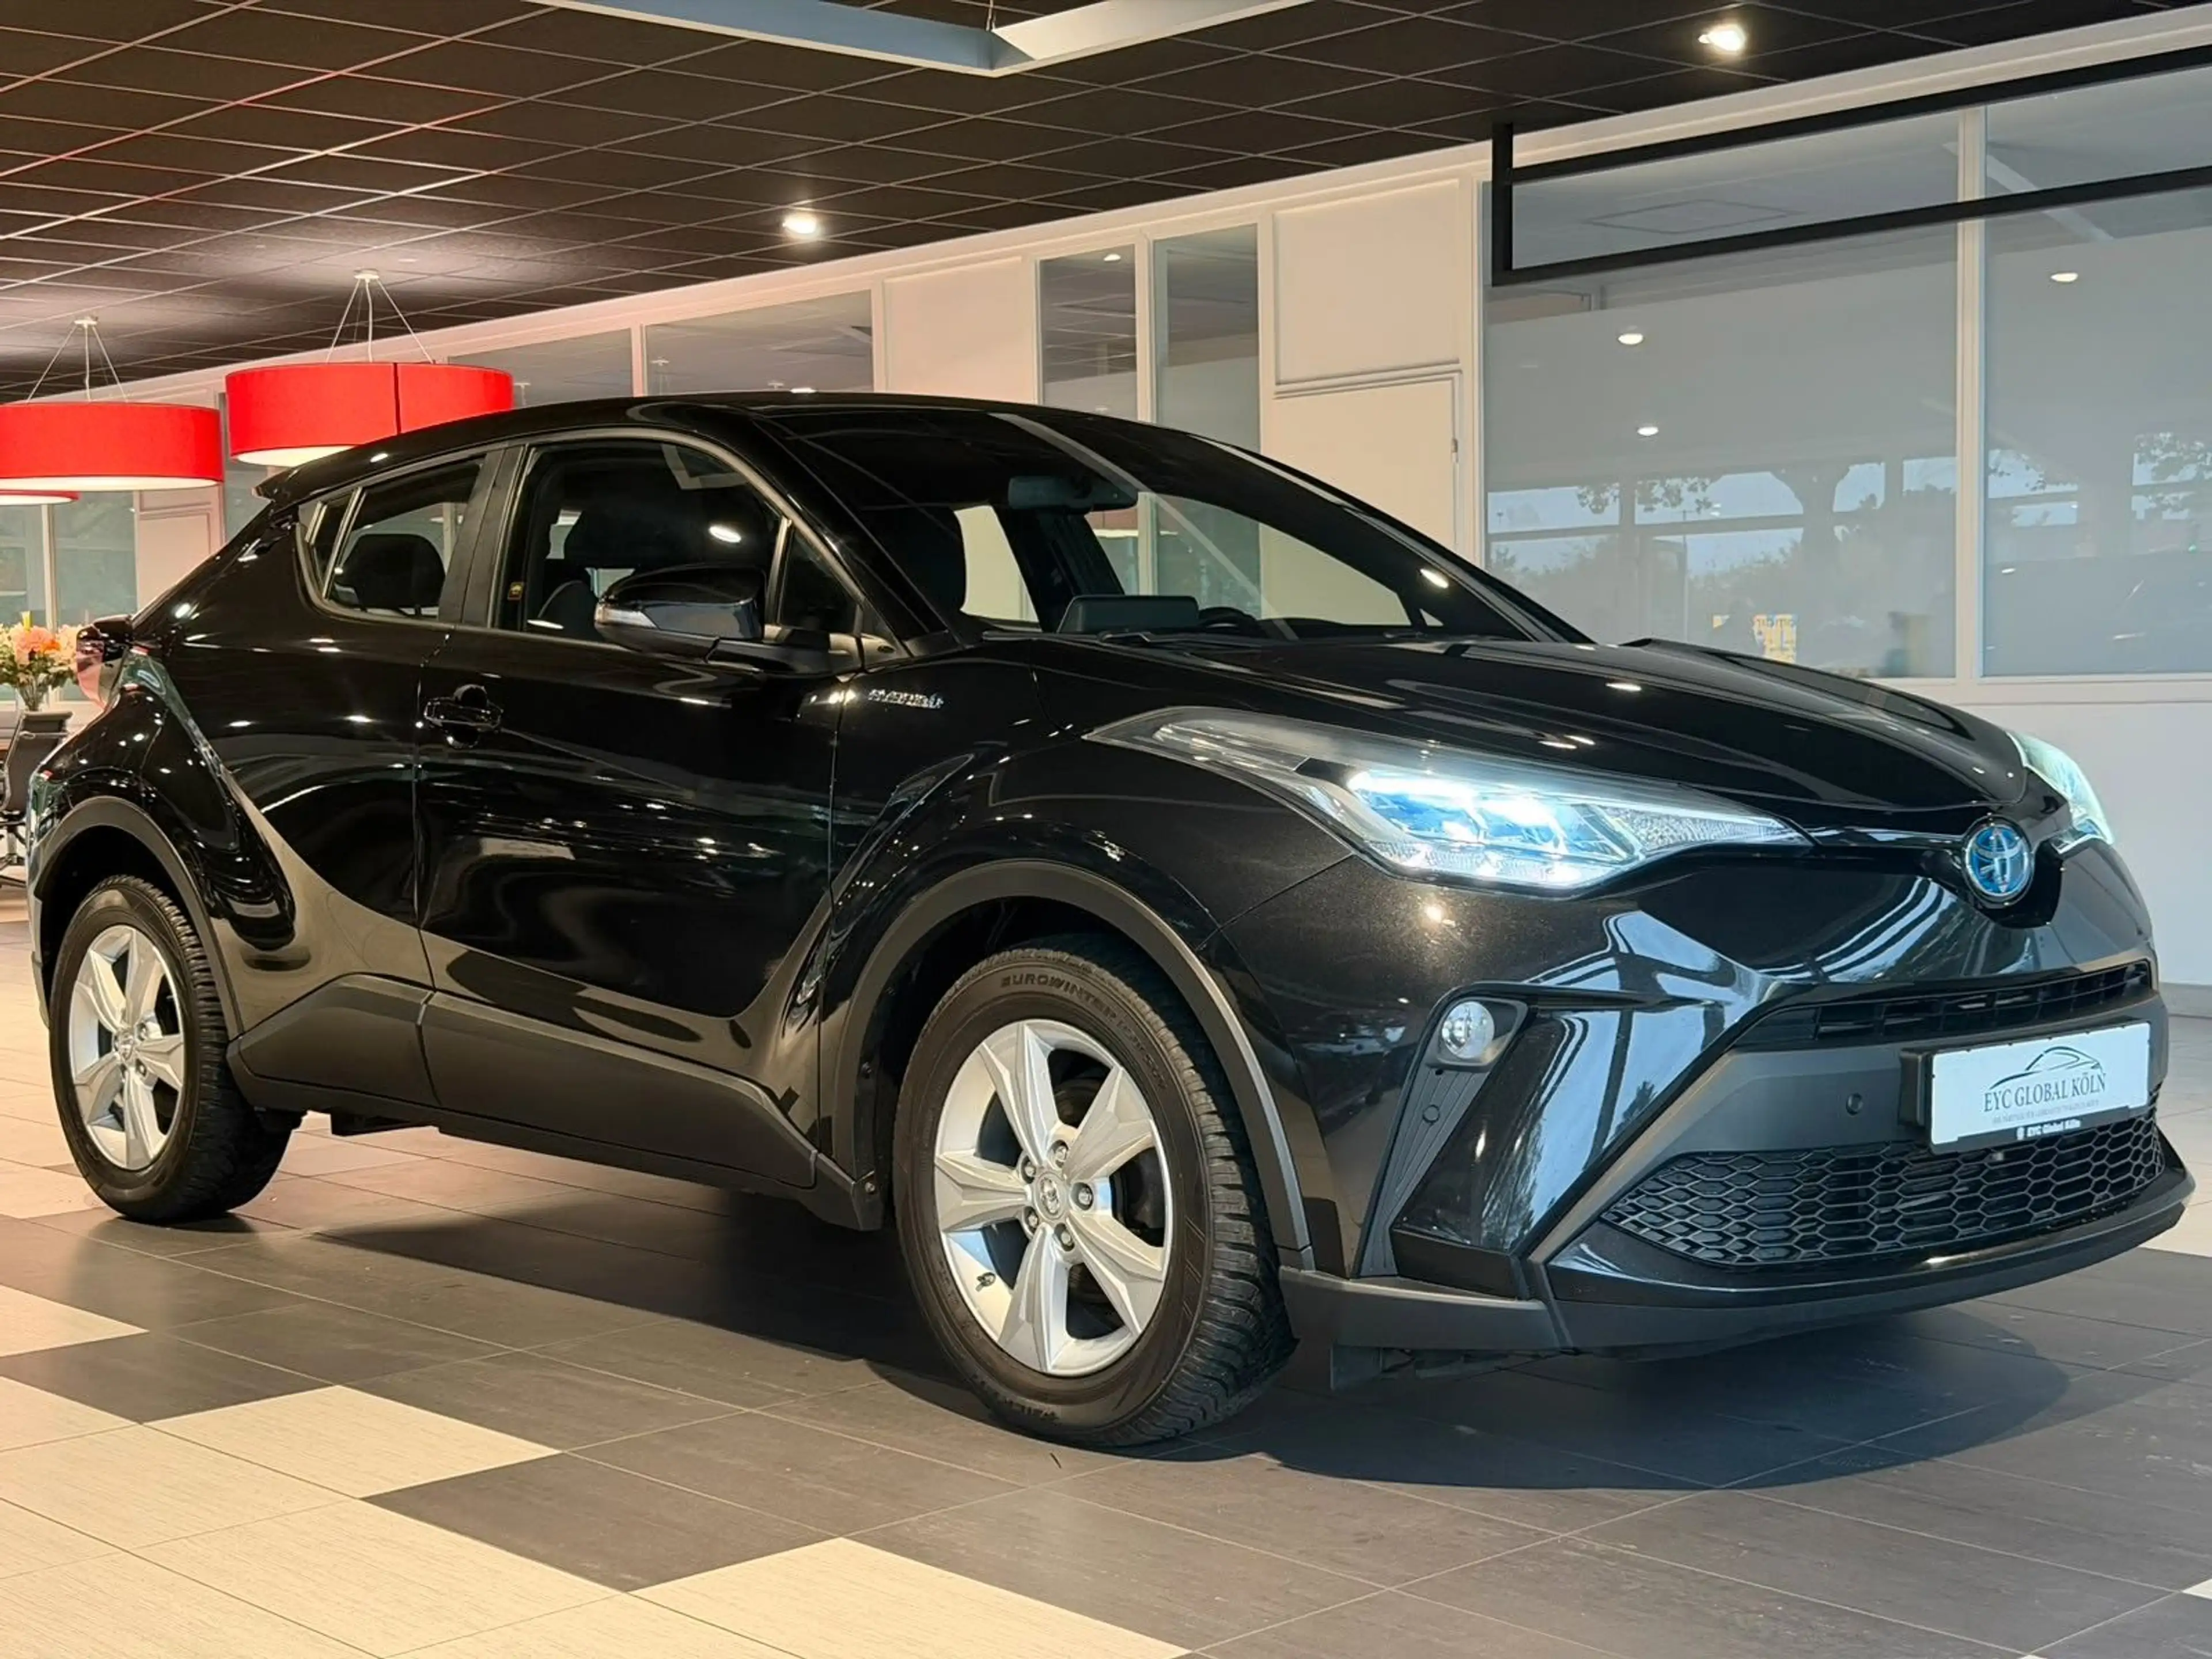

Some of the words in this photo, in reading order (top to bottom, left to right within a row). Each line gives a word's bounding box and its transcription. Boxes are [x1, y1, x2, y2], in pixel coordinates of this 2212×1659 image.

[1001, 974, 1116, 1019] EUROWINTER
[1984, 1089, 2012, 1112] EYC
[2014, 1080, 2068, 1107] GLOBAL
[2073, 1073, 2106, 1097] KÖLN
